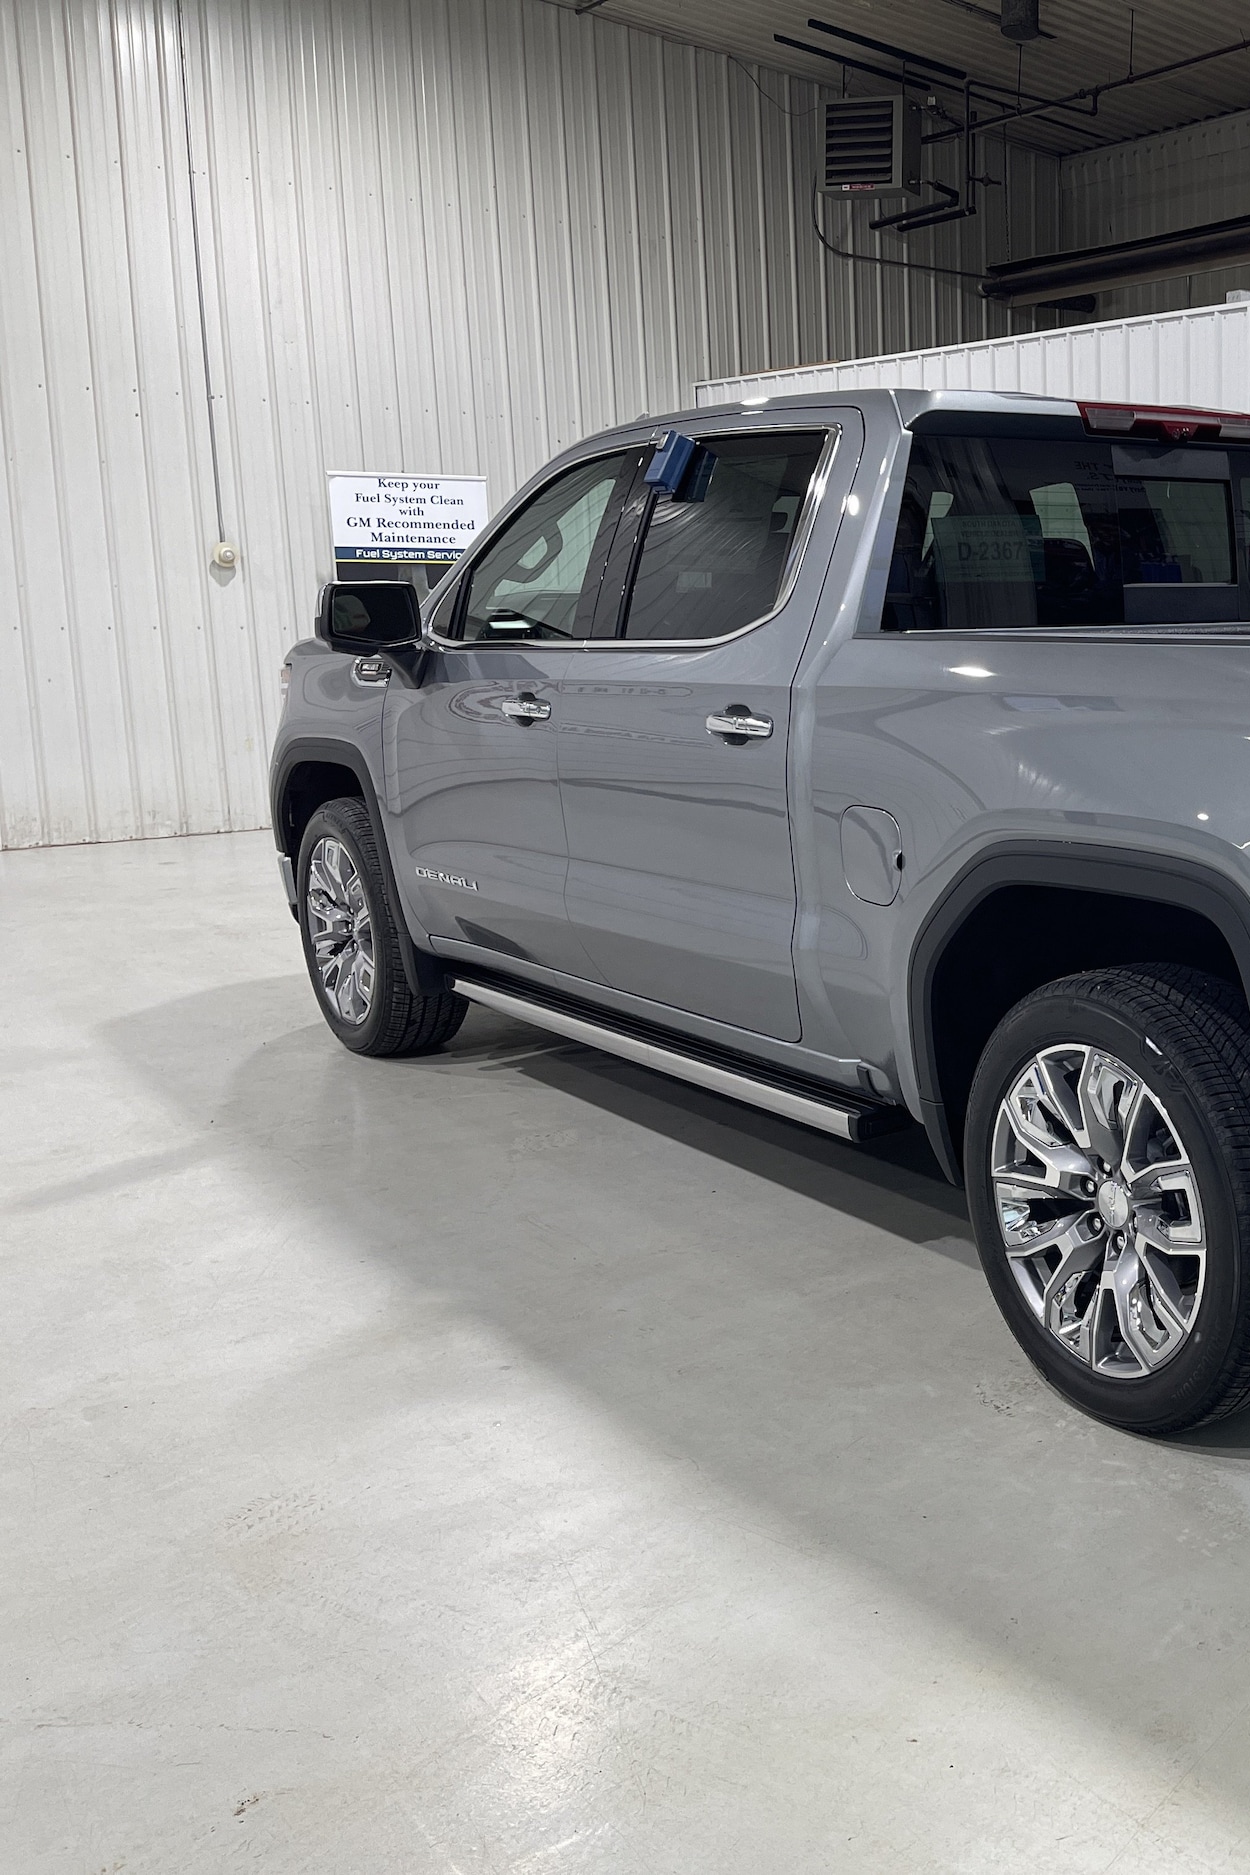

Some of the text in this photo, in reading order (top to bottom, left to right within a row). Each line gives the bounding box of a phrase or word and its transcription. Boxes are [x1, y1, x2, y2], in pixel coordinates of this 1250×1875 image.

[378, 478, 441, 492] Keep your
[355, 493, 464, 506] Fuel System Clean
[399, 506, 425, 516] with
[346, 517, 475, 530] GM Recommended
[370, 532, 456, 544] Maintenance
[356, 550, 462, 560] Fuel System Servic
[957, 541, 1024, 561] D-2367
[415, 866, 479, 892] DENALI
